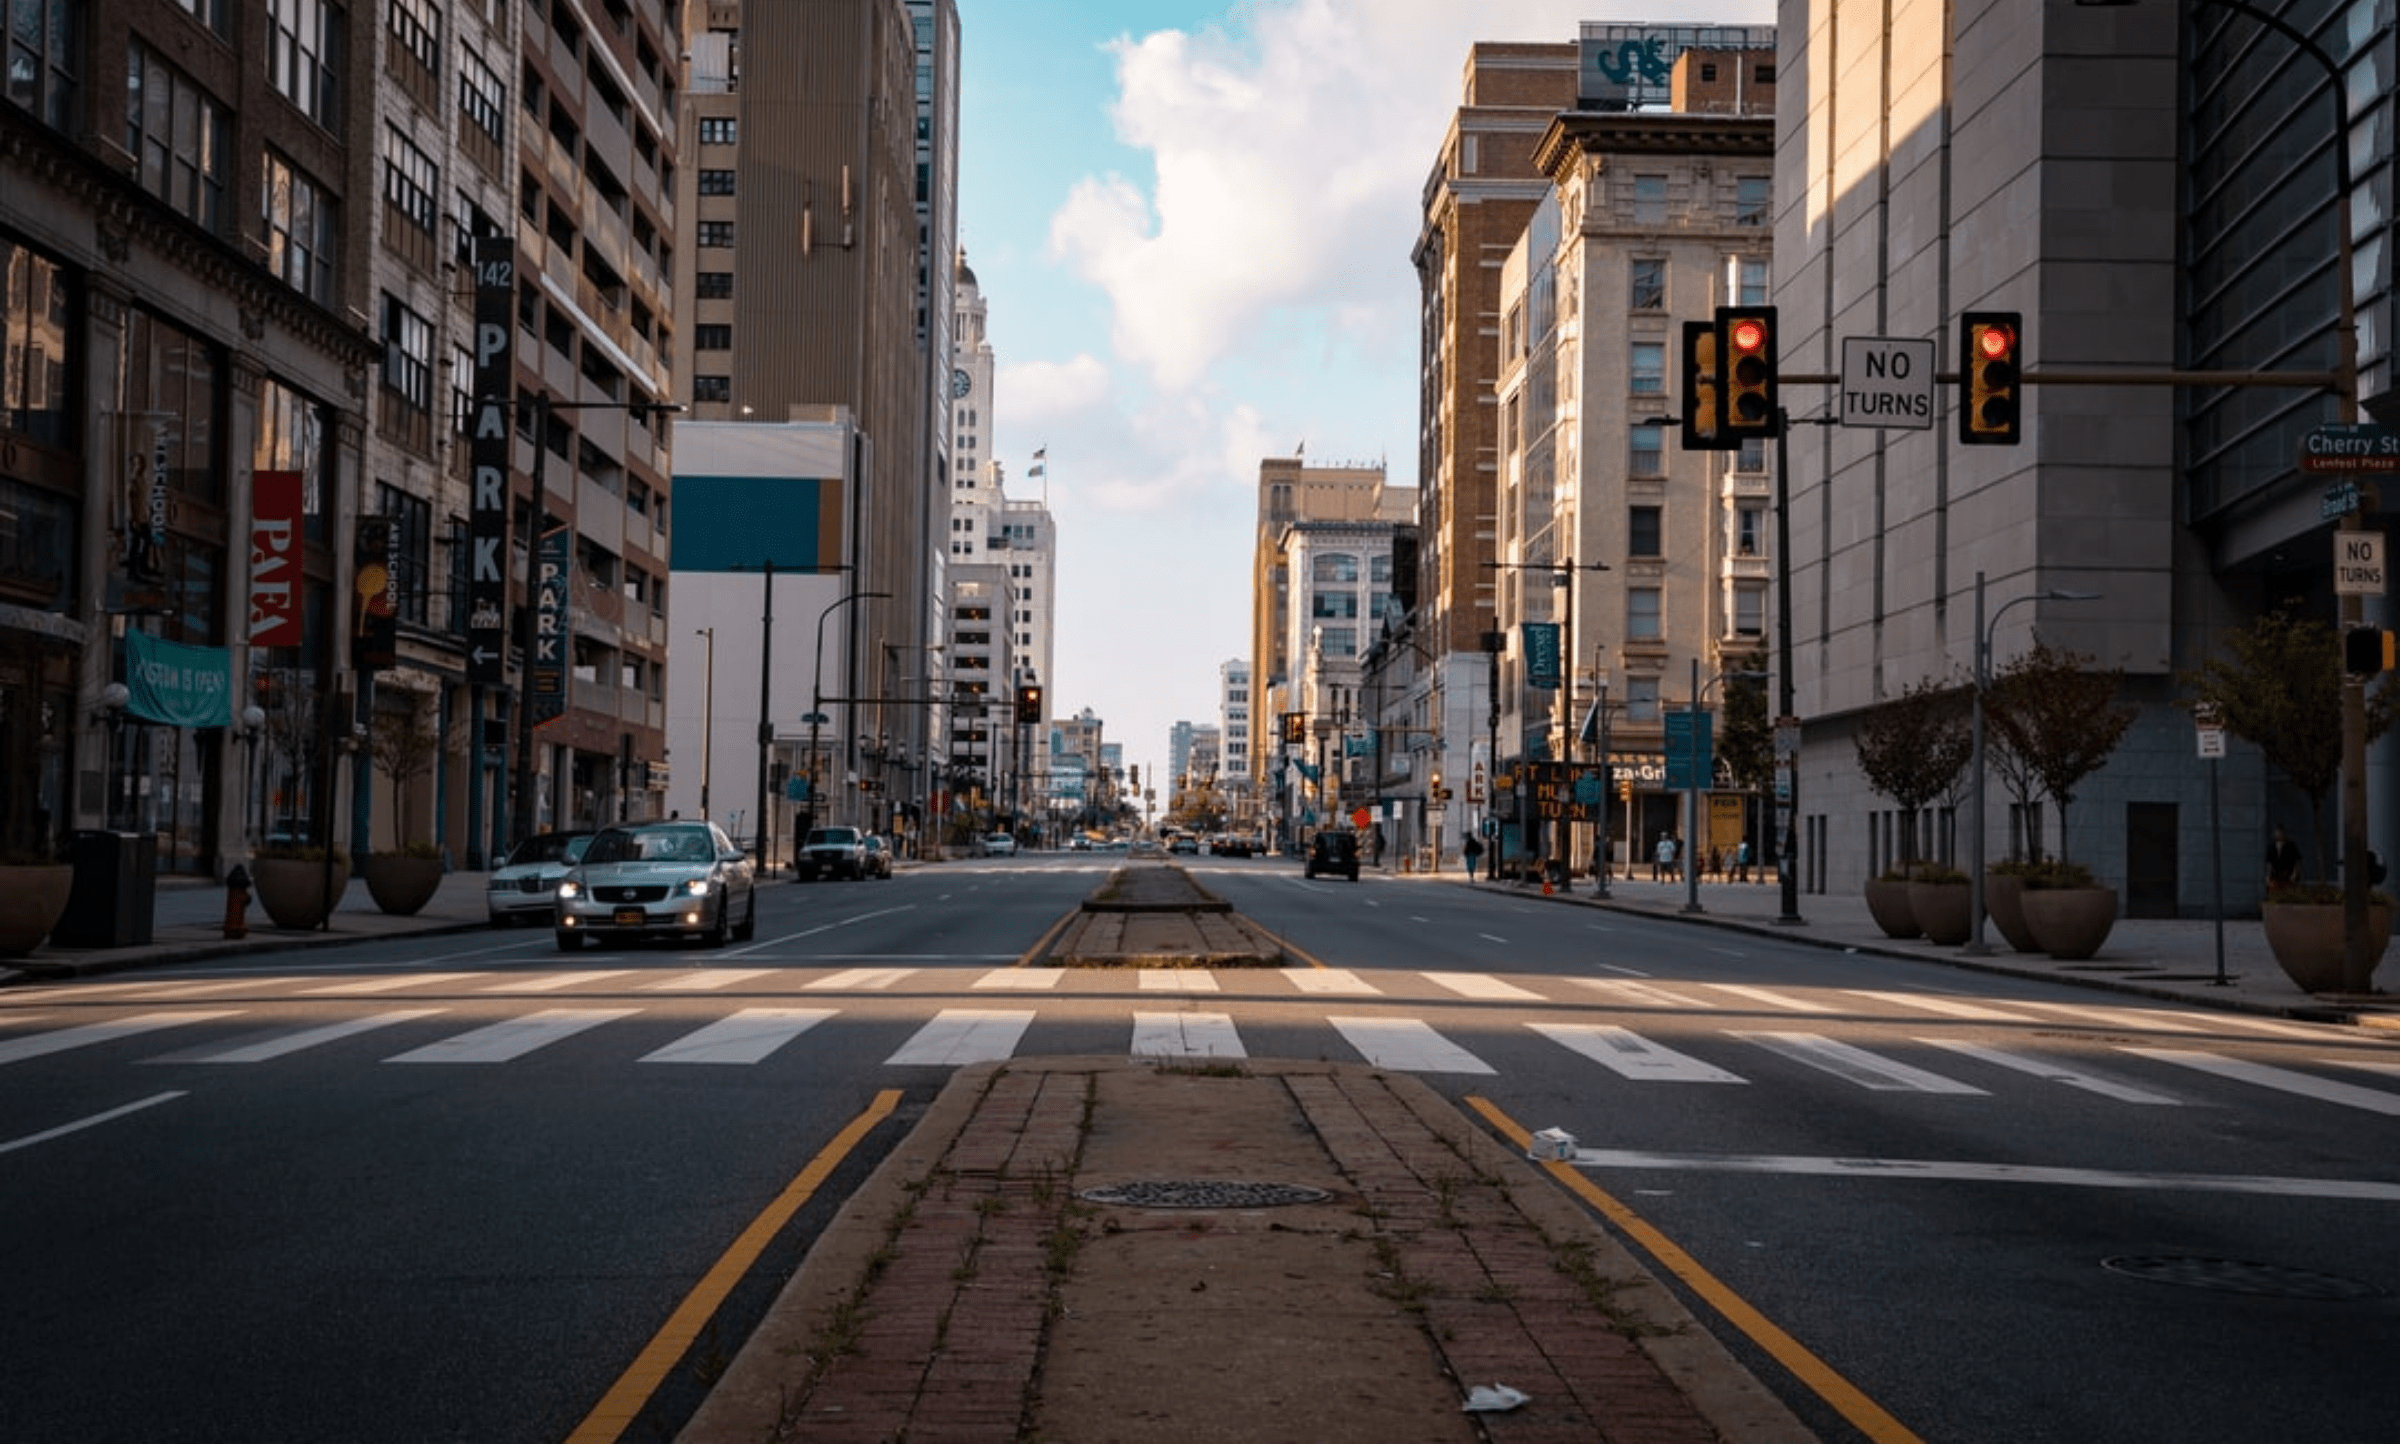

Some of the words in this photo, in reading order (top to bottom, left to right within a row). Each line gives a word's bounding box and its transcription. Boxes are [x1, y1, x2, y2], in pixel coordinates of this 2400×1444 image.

[477, 260, 512, 287] 142
[1866, 350, 1910, 379] NO
[1847, 391, 1928, 417] TURNS
[473, 322, 508, 583] PARK
[2308, 433, 2373, 456] Cherry
[2380, 435, 2400, 454] St
[2348, 542, 2372, 562] NO
[250, 517, 293, 641] PAFA
[386, 552, 399, 610] SCHOOL
[2340, 567, 2381, 584] TURNS
[537, 562, 561, 661] PARK
